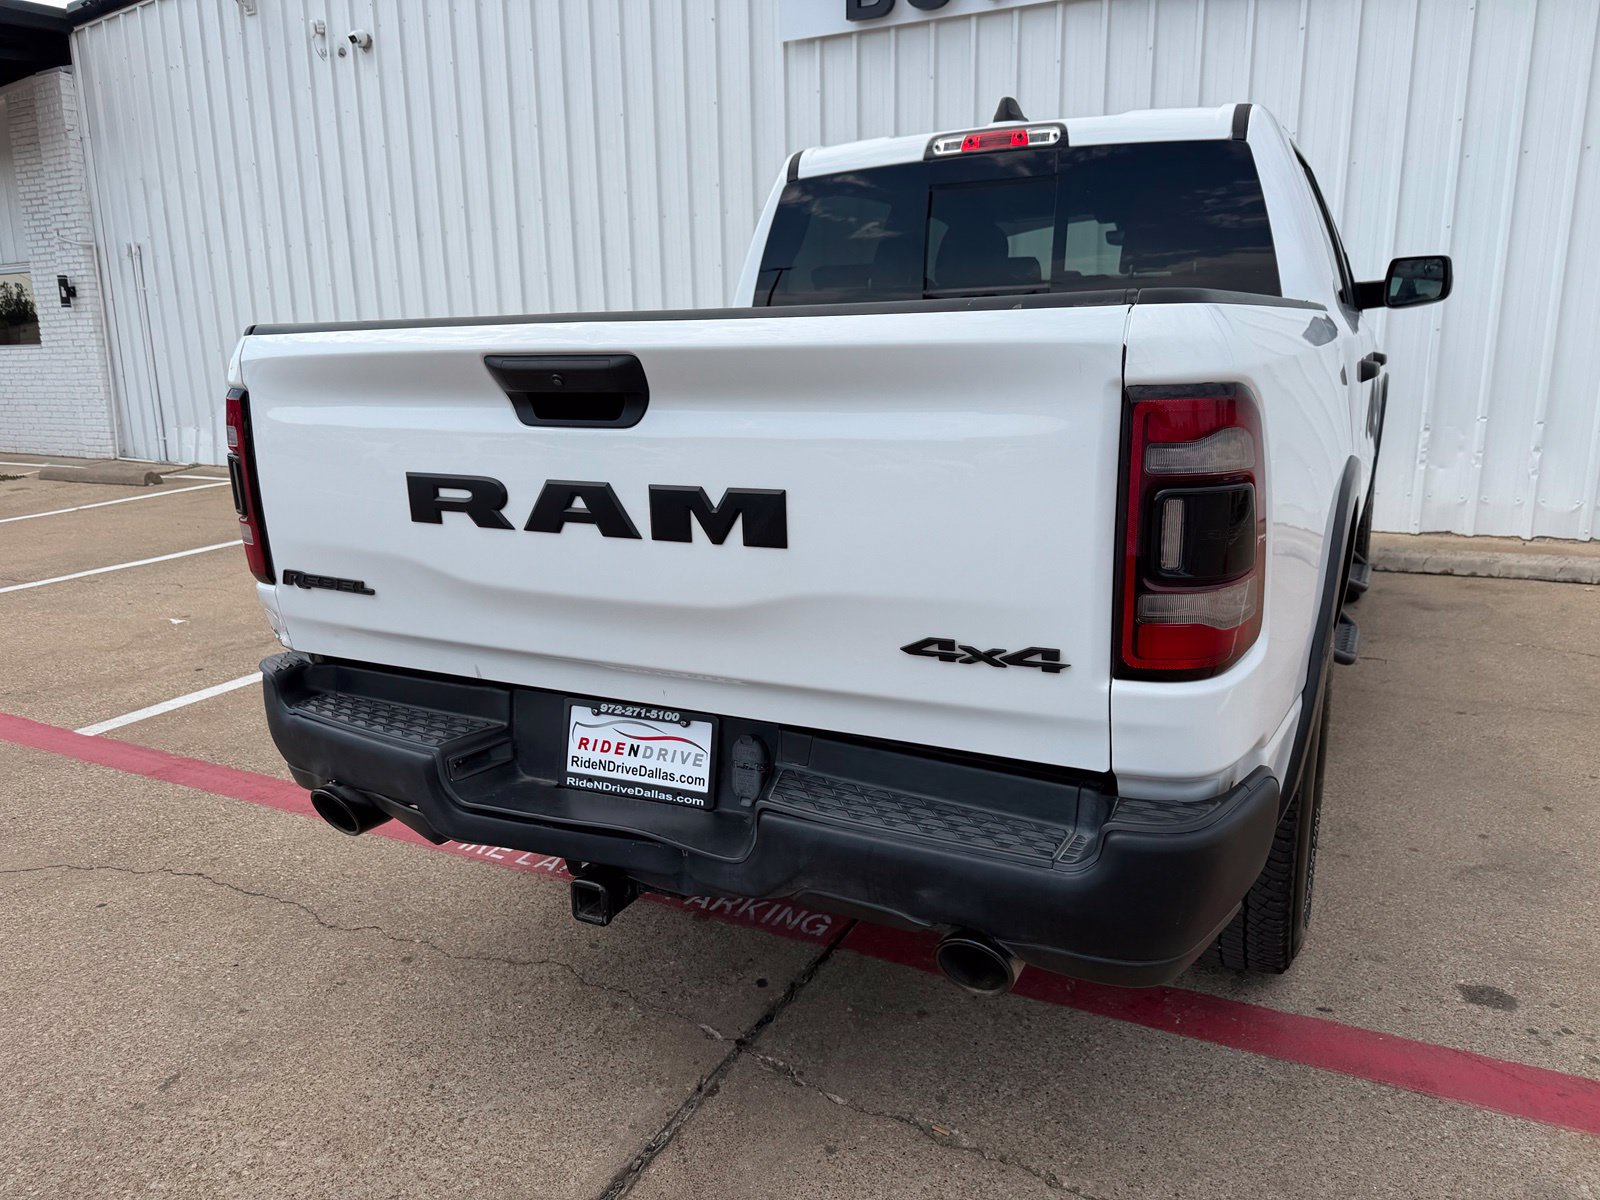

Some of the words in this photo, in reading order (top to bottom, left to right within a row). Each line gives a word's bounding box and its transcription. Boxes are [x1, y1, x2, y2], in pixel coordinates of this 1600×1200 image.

[406, 471, 788, 549] RAM
[283, 569, 375, 595] REBEL
[900, 637, 1071, 673] 4x4
[600, 703, 680, 722] 972-271-5100
[571, 756, 705, 787] RideNDriveDallas.com
[566, 776, 704, 806] RideNDriveDallas.com
